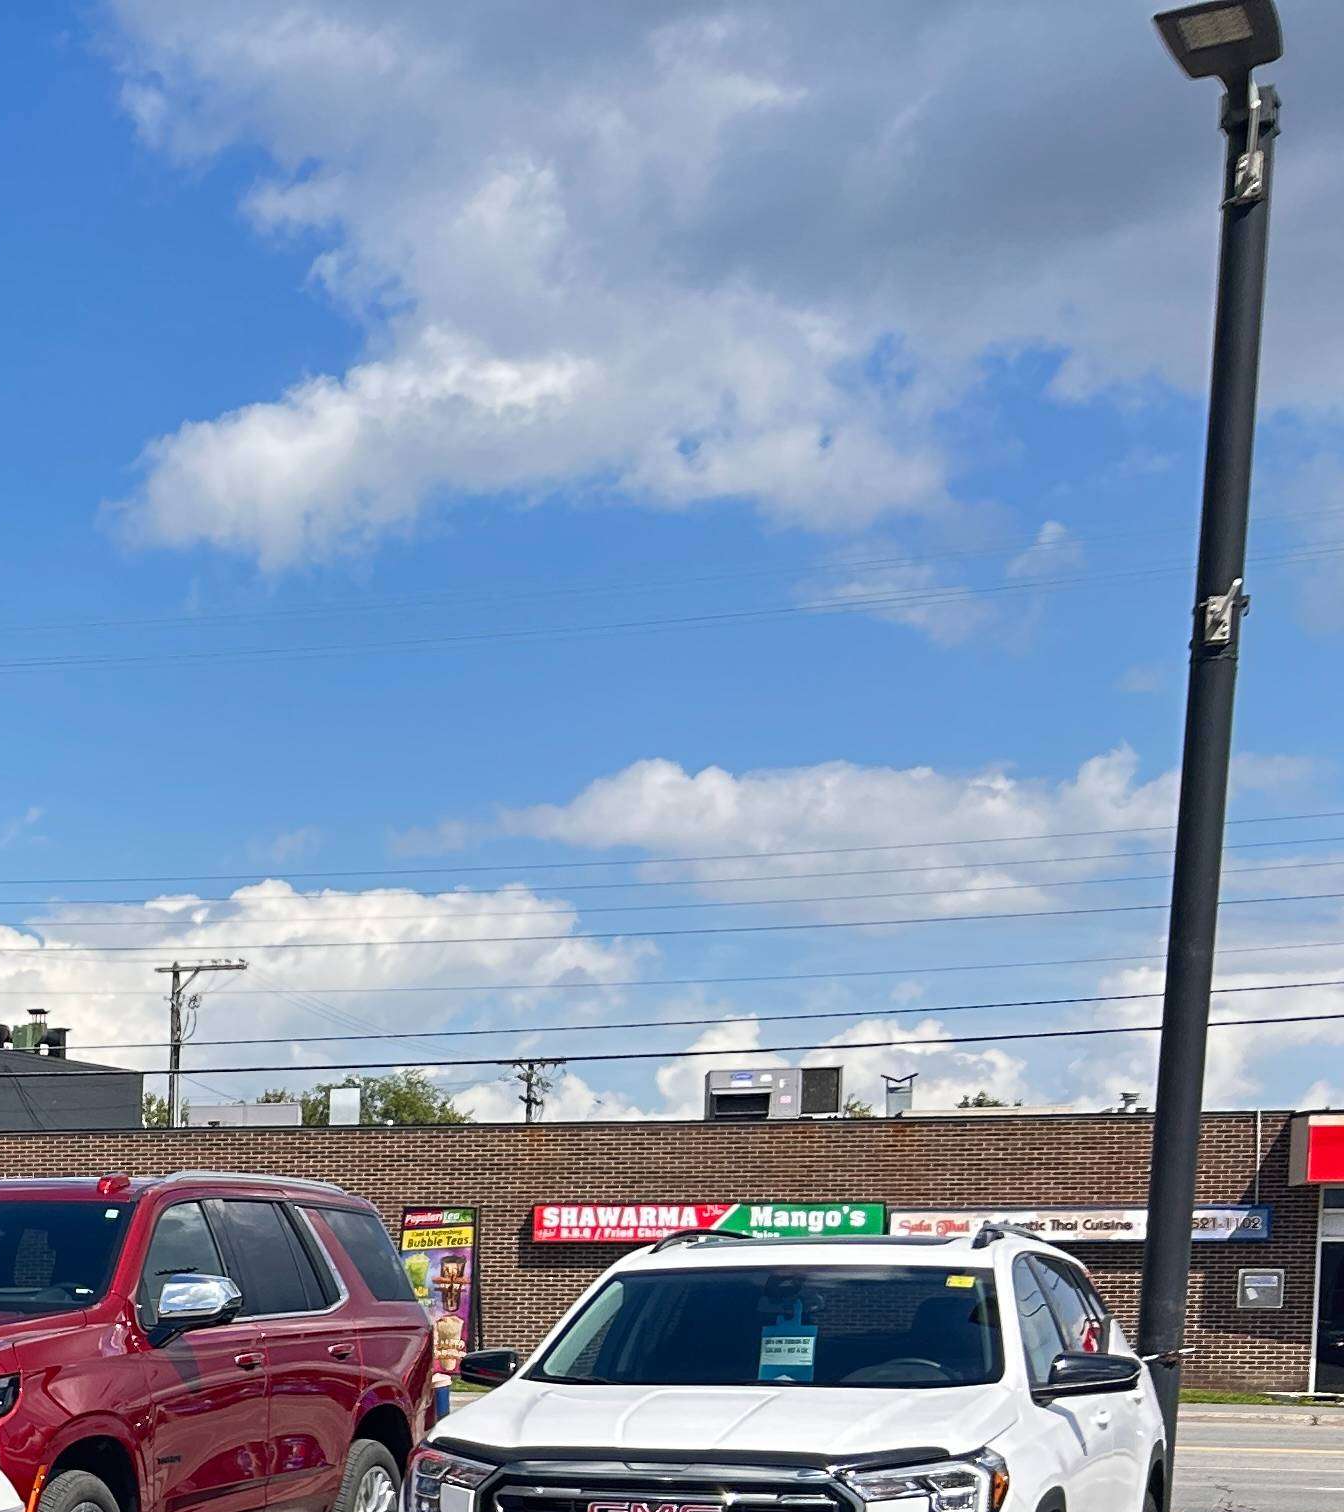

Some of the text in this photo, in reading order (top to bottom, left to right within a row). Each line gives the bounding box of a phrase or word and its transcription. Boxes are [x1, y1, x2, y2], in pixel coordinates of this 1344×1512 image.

[542, 1206, 699, 1227] SHAWARMA
[749, 1205, 867, 1232] Mango's
[1050, 1219, 1078, 1231] Thai
[1083, 1219, 1133, 1231] Cuisine
[604, 1228, 634, 1238] Fried
[407, 1236, 443, 1248] Bubble
